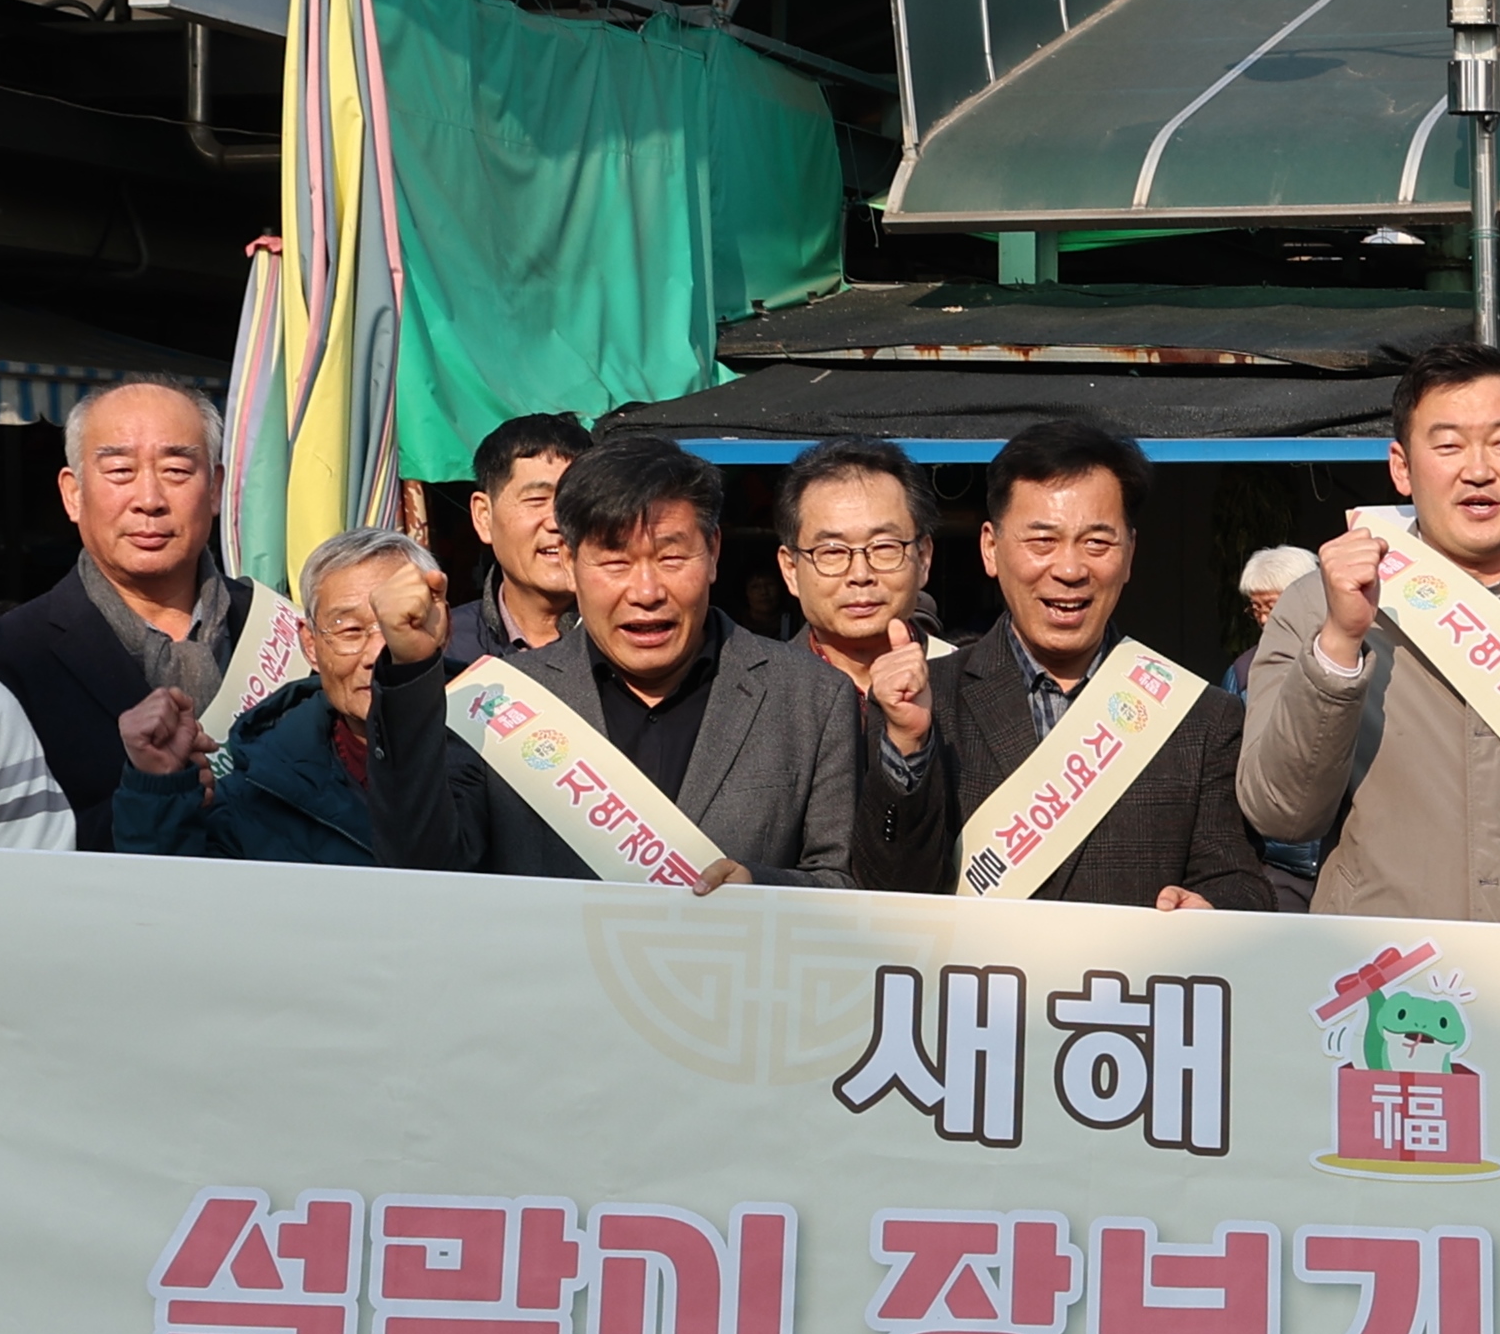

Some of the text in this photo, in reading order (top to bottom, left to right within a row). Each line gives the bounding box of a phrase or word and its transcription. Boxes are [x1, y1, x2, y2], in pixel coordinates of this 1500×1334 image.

[556, 760, 701, 886] 지역경제
[964, 722, 1123, 896] 지역경제를
[833, 965, 1231, 1156] 새해
[1372, 1083, 1447, 1152] 福
